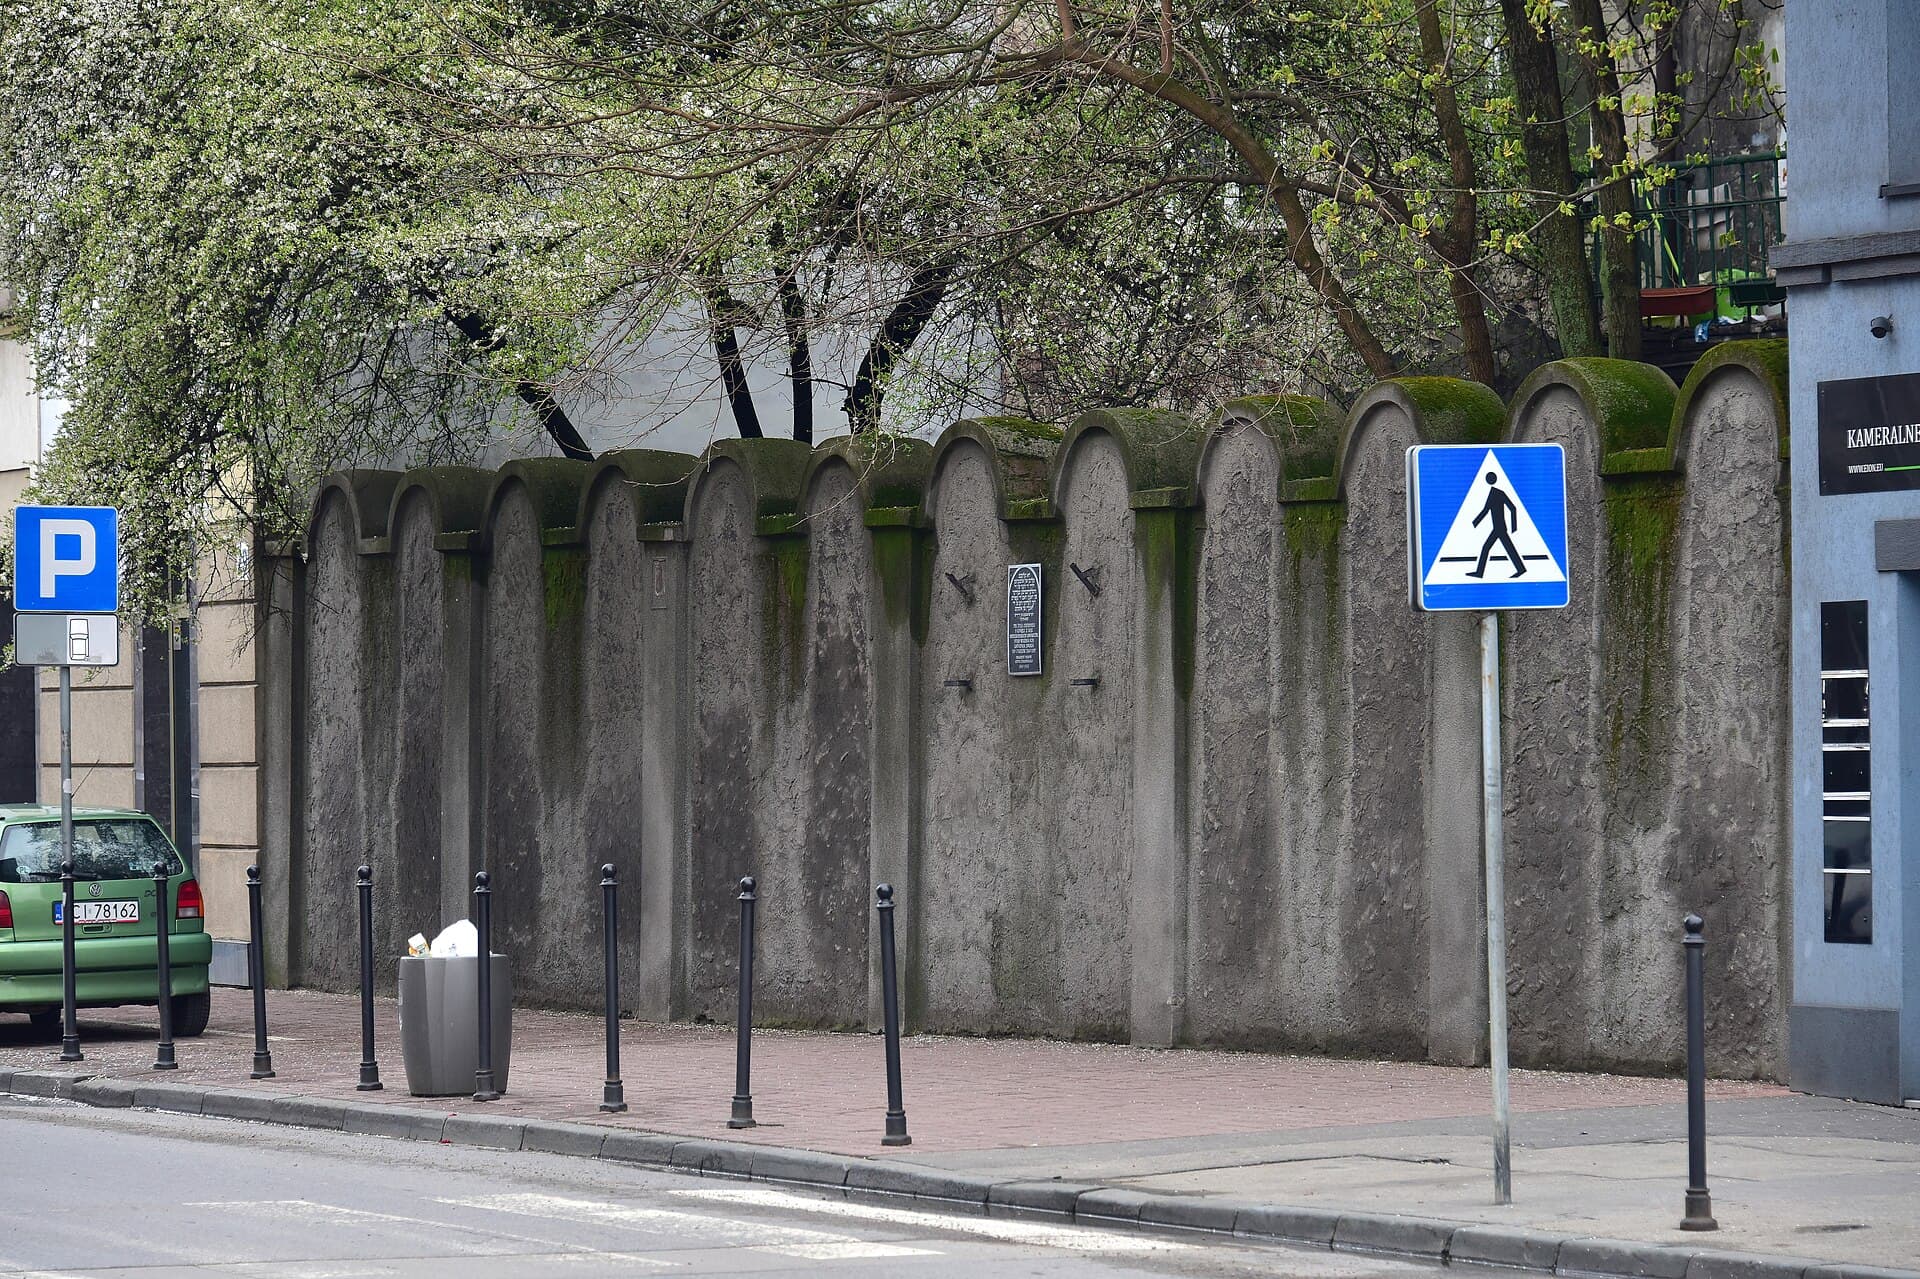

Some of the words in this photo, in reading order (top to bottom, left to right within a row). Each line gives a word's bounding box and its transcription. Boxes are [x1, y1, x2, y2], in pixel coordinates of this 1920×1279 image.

[1847, 423, 1920, 449] KAMERALNE
[39, 518, 96, 598] P
[94, 903, 137, 919] 78162
